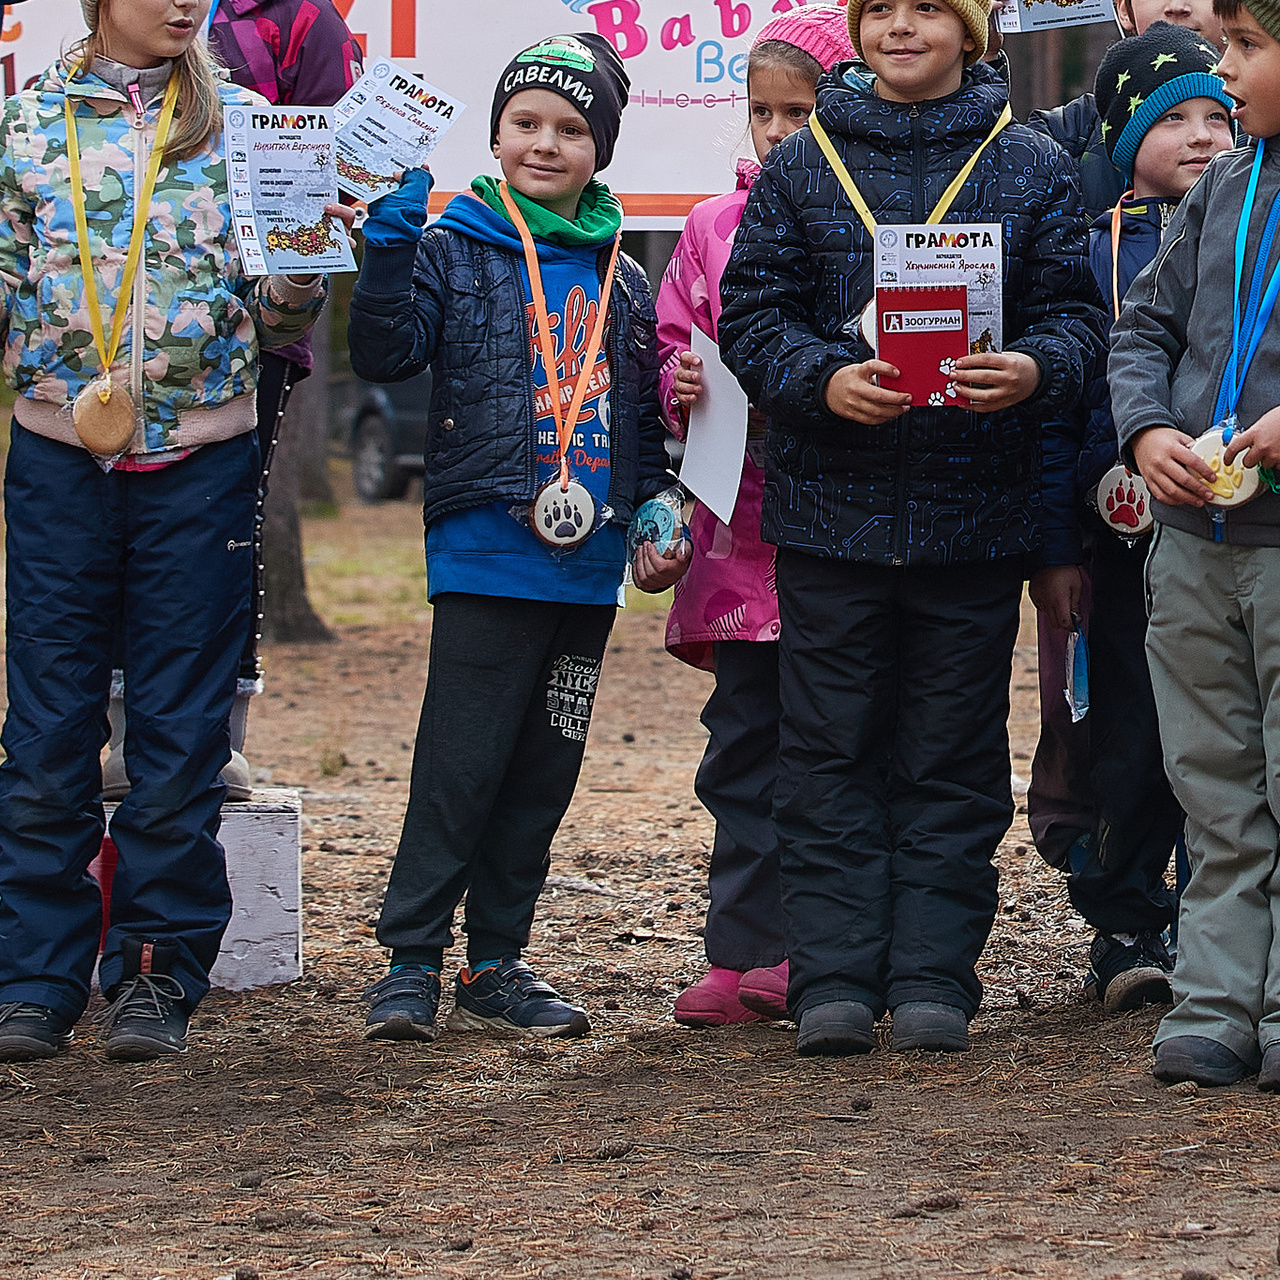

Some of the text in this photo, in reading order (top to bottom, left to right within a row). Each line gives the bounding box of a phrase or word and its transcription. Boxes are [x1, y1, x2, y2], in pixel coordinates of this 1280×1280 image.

[389, 74, 455, 120] ГРАМОТА
[503, 65, 595, 110] САВЕЛИЙ
[251, 113, 329, 130] ГРАМОТА
[905, 232, 994, 248] ГРАМОТА
[904, 316, 962, 327] ЗООГУРМАН
[546, 690, 594, 717] STA
